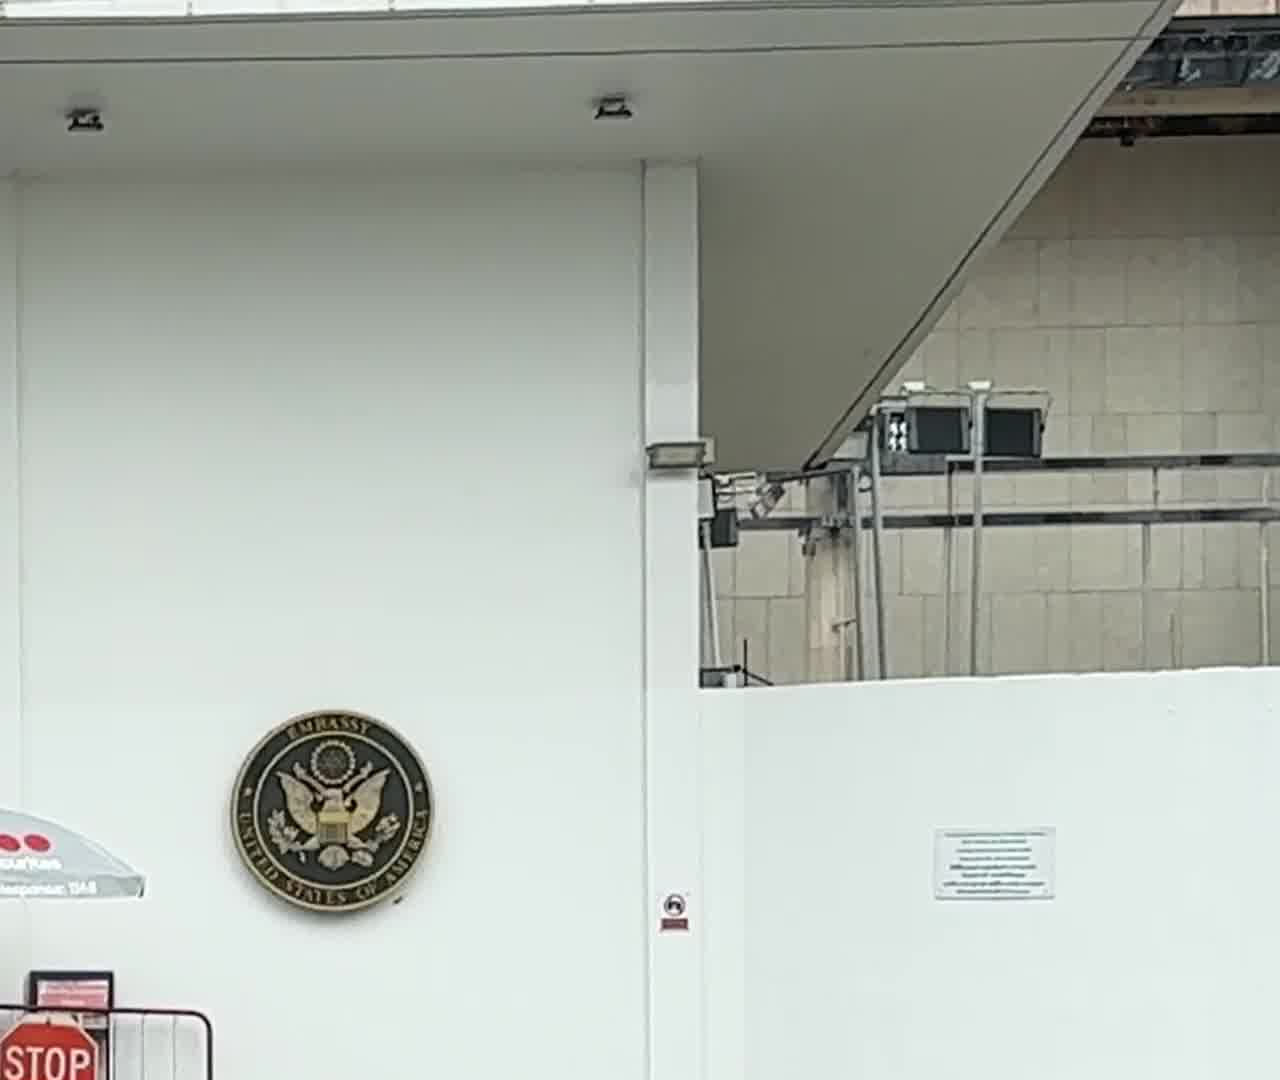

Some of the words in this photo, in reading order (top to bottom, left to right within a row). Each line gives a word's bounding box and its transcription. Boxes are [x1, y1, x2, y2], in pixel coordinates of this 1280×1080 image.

[286, 716, 369, 740] EMBASSY
[239, 812, 278, 881] UNITED
[285, 880, 348, 904] STATES
[355, 885, 377, 899] OF
[383, 810, 429, 885] AMERICA
